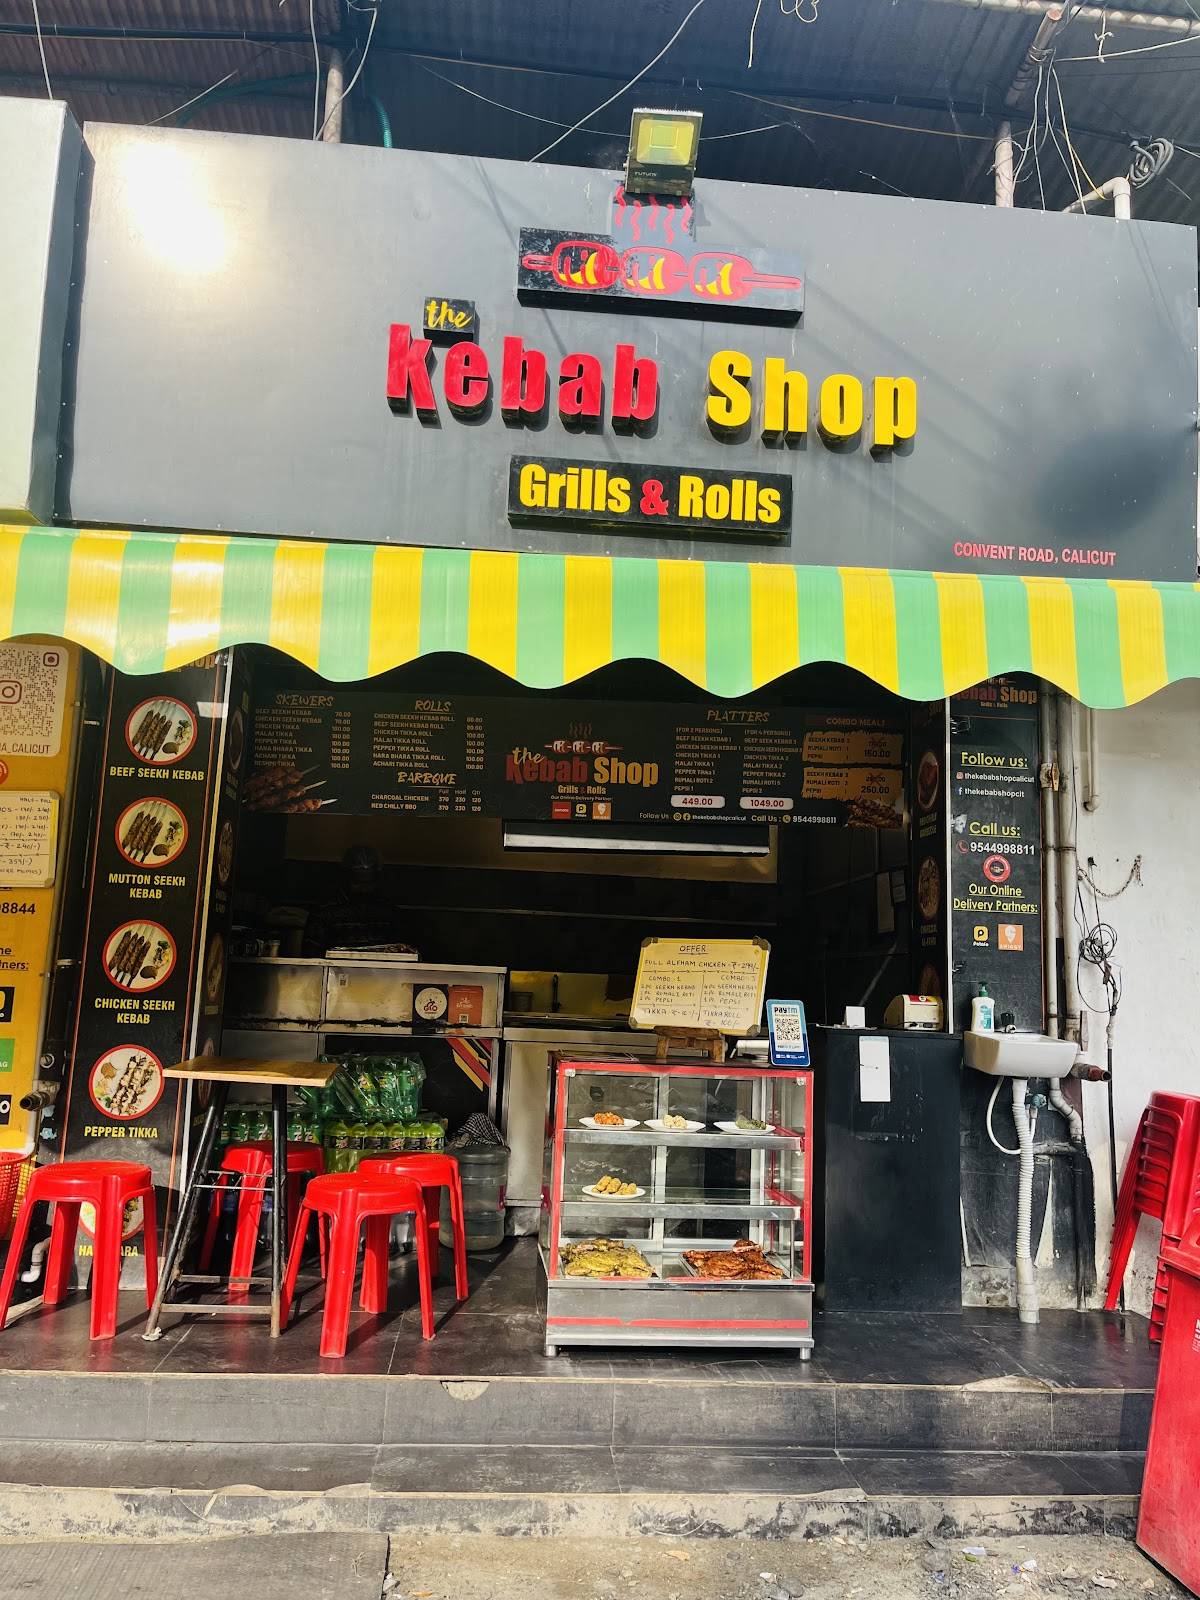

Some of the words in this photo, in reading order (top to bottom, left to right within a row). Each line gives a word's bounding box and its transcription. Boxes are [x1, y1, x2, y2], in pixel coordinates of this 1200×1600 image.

[426, 299, 472, 329] the
[707, 350, 917, 446] Shop
[519, 464, 631, 514] Grills
[640, 479, 669, 516] &
[678, 476, 781, 524] Rolls
[954, 542, 1015, 560] CONVENT
[1018, 546, 1058, 564] ROAD,
[1062, 548, 1116, 566] CALICUT
[276, 694, 335, 706] SKEWERS
[1000, 686, 1038, 704] Shop
[415, 700, 452, 712] ROLLS
[707, 710, 770, 722] PLATTERS
[512, 746, 546, 765] the
[961, 752, 1004, 765] Follow
[1009, 757, 1028, 768] us:
[110, 766, 135, 778] BEEF
[138, 768, 169, 779] SEEKH
[172, 769, 205, 781] KEBAB
[594, 756, 658, 787] Shop
[558, 785, 579, 794] Grills
[587, 786, 606, 795] Rolls
[751, 799, 784, 807] 1049.00
[969, 822, 997, 834] Call
[1002, 826, 1020, 836] us:
[970, 842, 1035, 854] 9544998811
[108, 873, 151, 884] MUTTON
[154, 875, 185, 886] SEEKH
[129, 888, 162, 899] KEBAB
[969, 883, 986, 894] Our
[990, 884, 1022, 896] Online
[953, 898, 993, 911] Delivery
[996, 900, 1038, 912] Partners:
[94, 998, 140, 1009] CHICKEN
[142, 1000, 176, 1010] SEEKH
[116, 1013, 151, 1024] KEBAB
[84, 1126, 125, 1138] PEPPER
[129, 1127, 158, 1138] TIKKA
